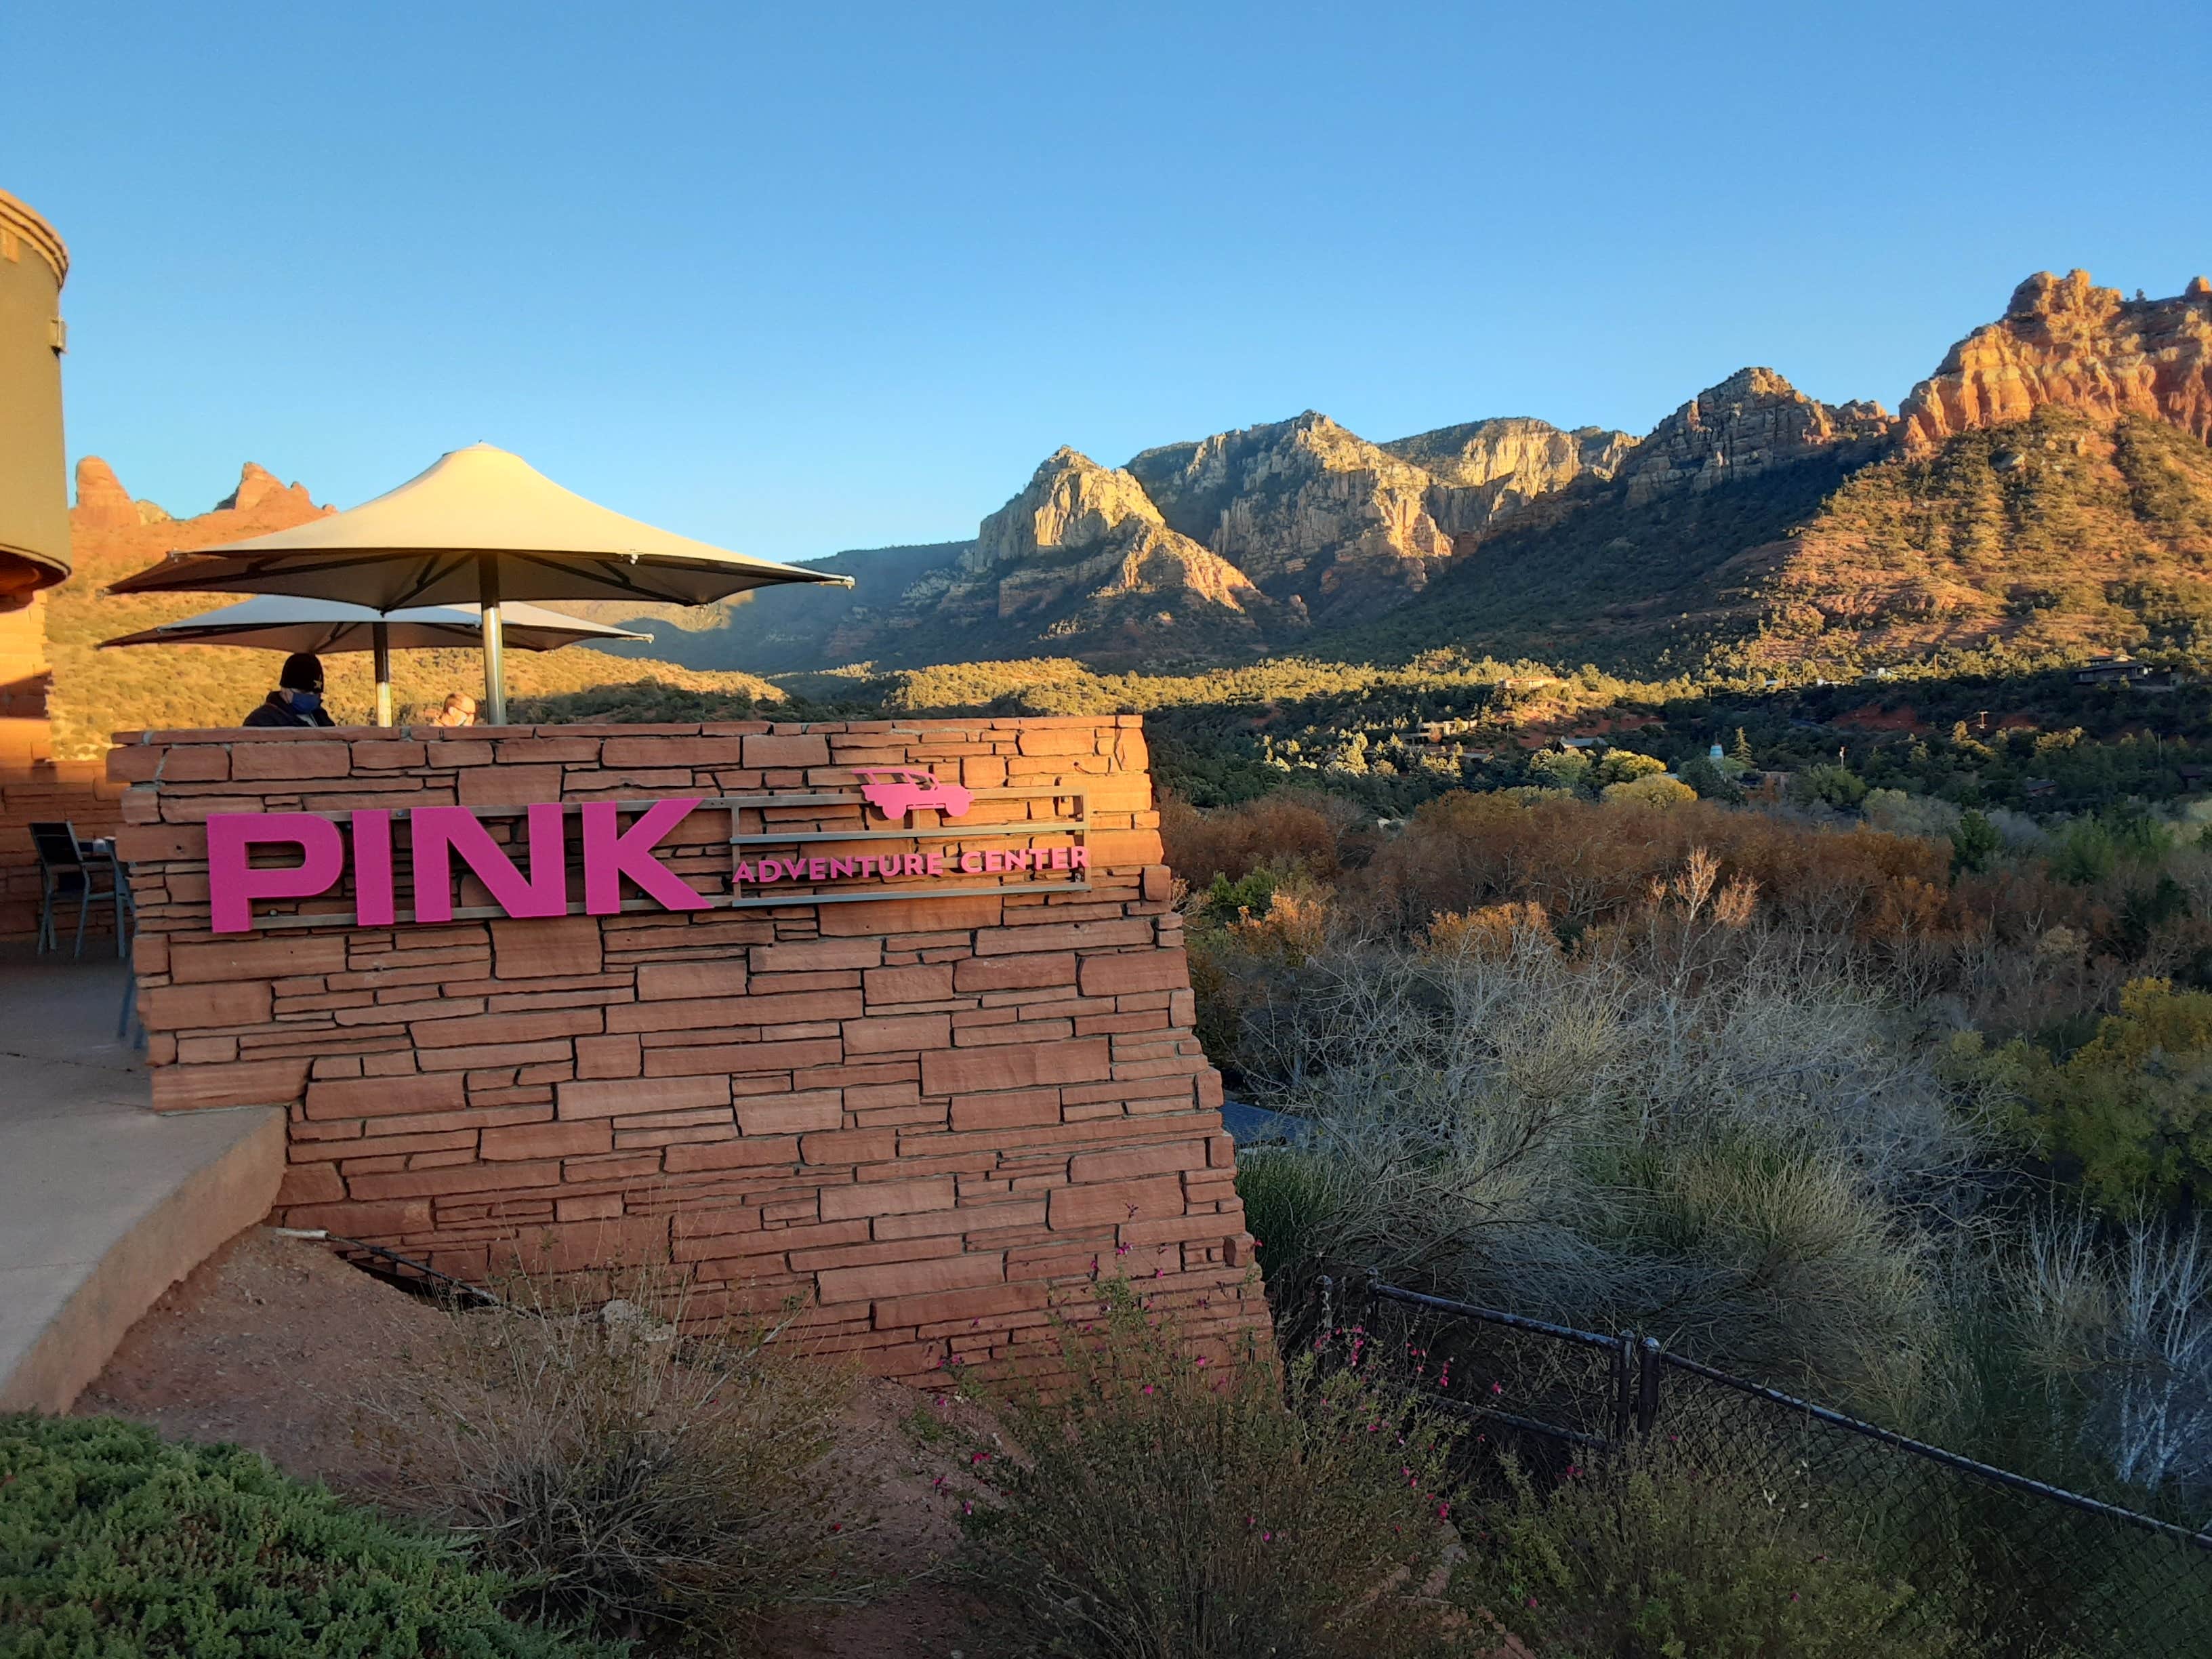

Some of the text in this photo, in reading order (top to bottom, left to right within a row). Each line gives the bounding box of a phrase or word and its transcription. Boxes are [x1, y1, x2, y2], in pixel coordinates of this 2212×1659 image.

[207, 798, 715, 933] PINK
[732, 846, 1090, 883] ADVENTURE CENTER
